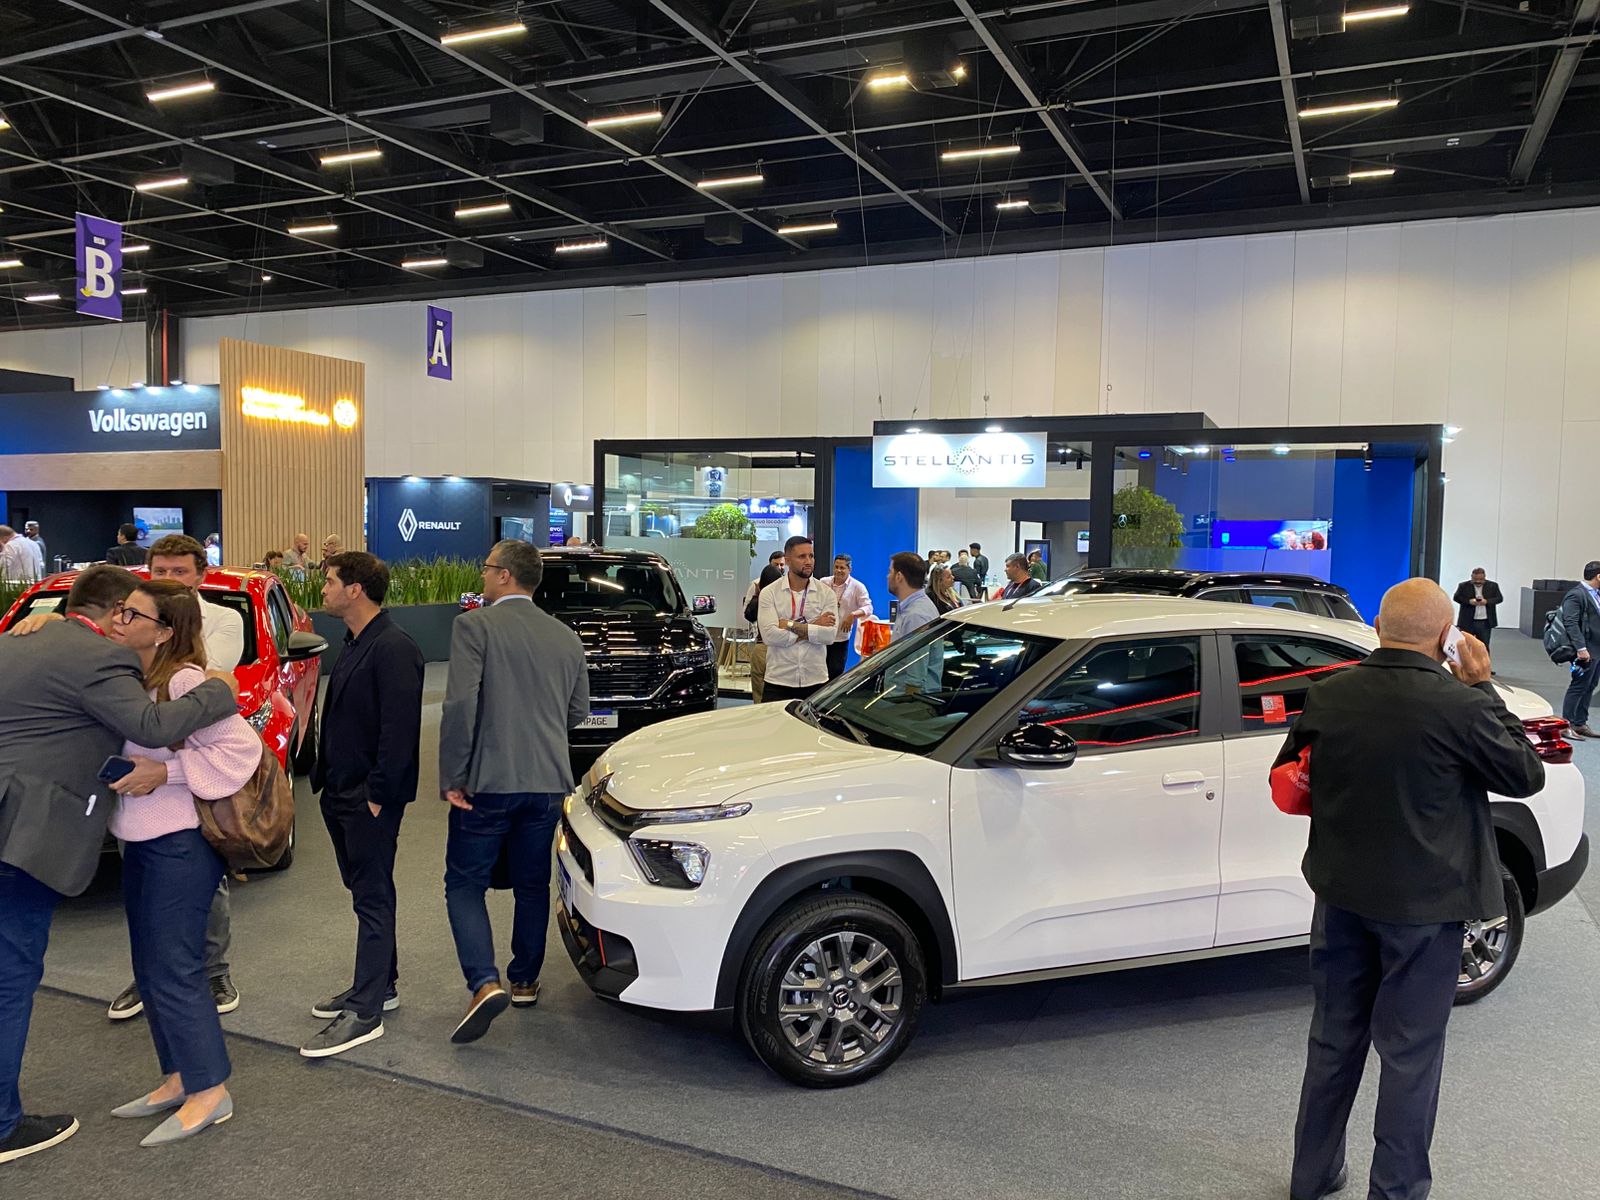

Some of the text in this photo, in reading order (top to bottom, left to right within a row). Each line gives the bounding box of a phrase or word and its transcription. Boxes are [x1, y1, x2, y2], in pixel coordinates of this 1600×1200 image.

[85, 246, 115, 299] B
[432, 329, 448, 367] A
[88, 408, 208, 437] Volkswagen
[884, 453, 1035, 466] STELLANTIS
[418, 521, 462, 530] RENAULT
